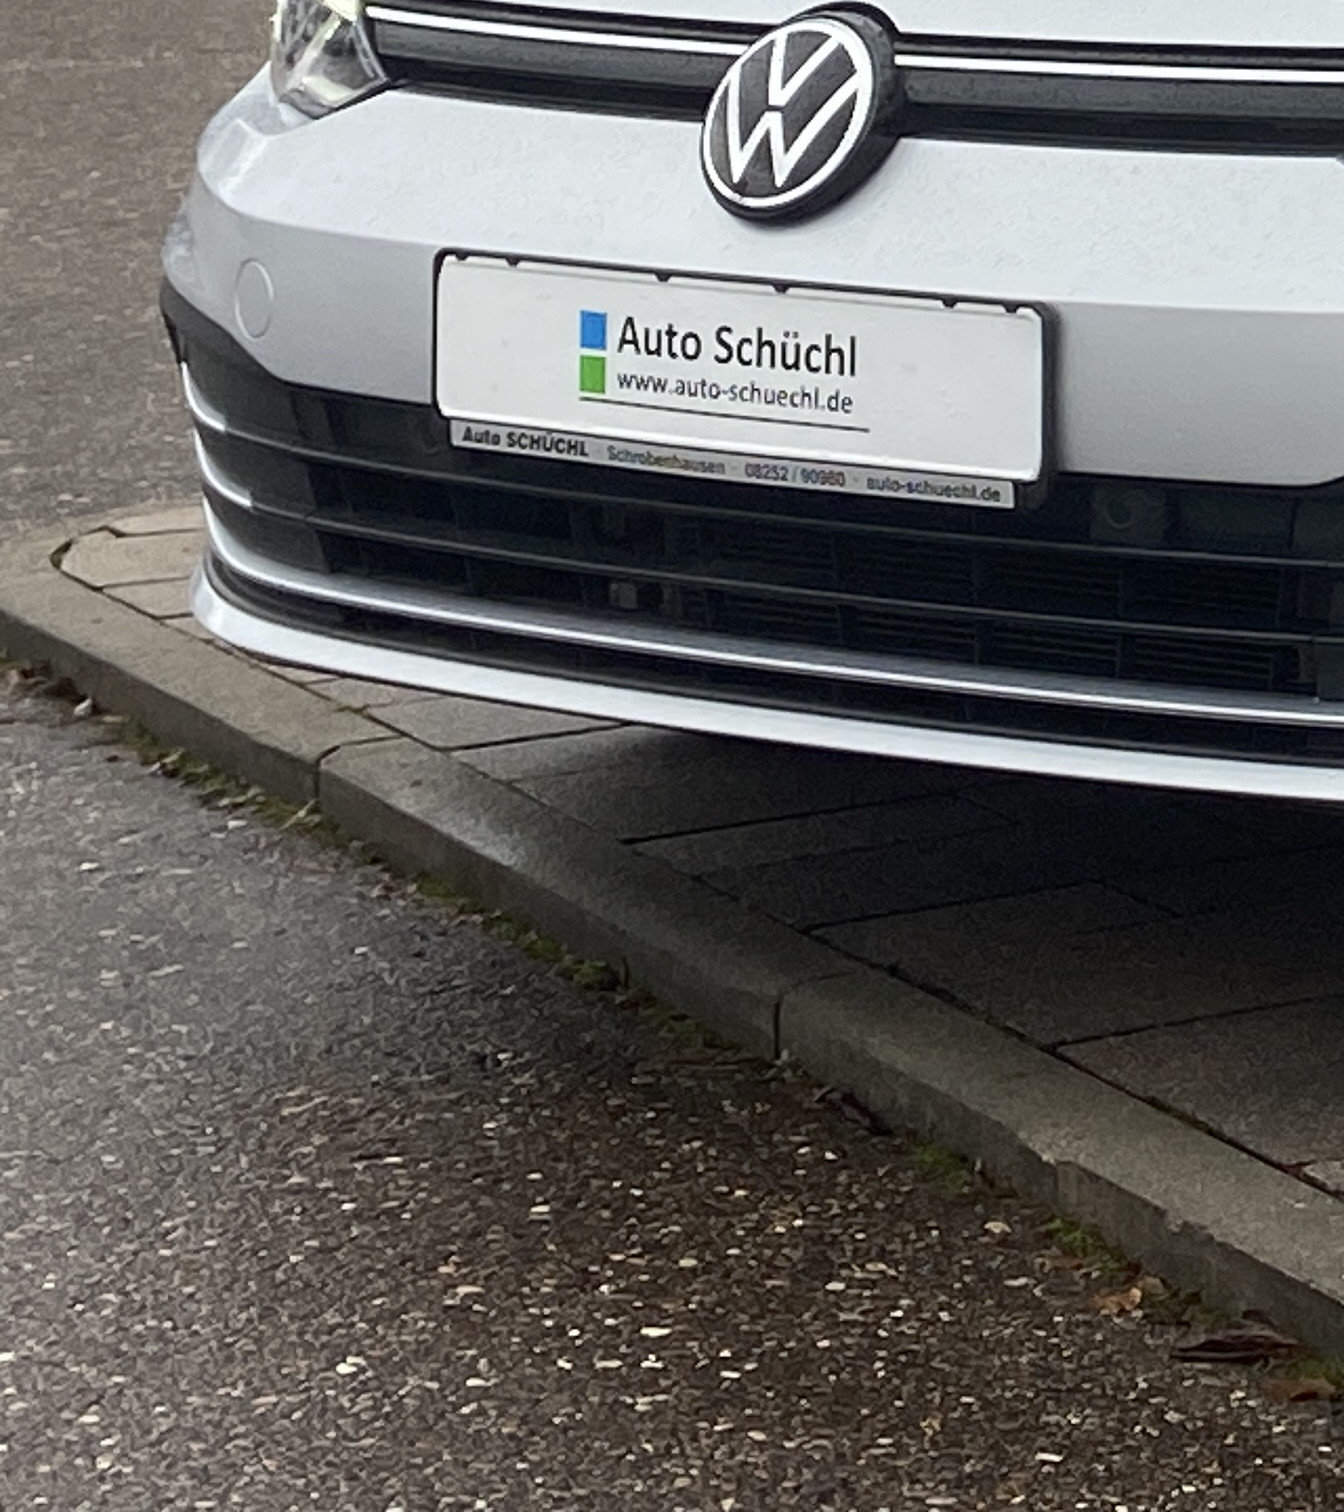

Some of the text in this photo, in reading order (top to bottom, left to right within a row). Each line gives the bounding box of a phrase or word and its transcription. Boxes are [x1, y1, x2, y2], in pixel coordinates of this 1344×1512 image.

[616, 316, 857, 377] Auto Schüchl
[616, 372, 854, 414] www.auto-schuechl.de
[461, 426, 501, 446] Auto
[506, 430, 590, 458] SCHÜCHL
[606, 445, 726, 475] Schrobenhausen
[744, 462, 789, 482] 08252
[866, 476, 1002, 502] auto-schuechl.de
